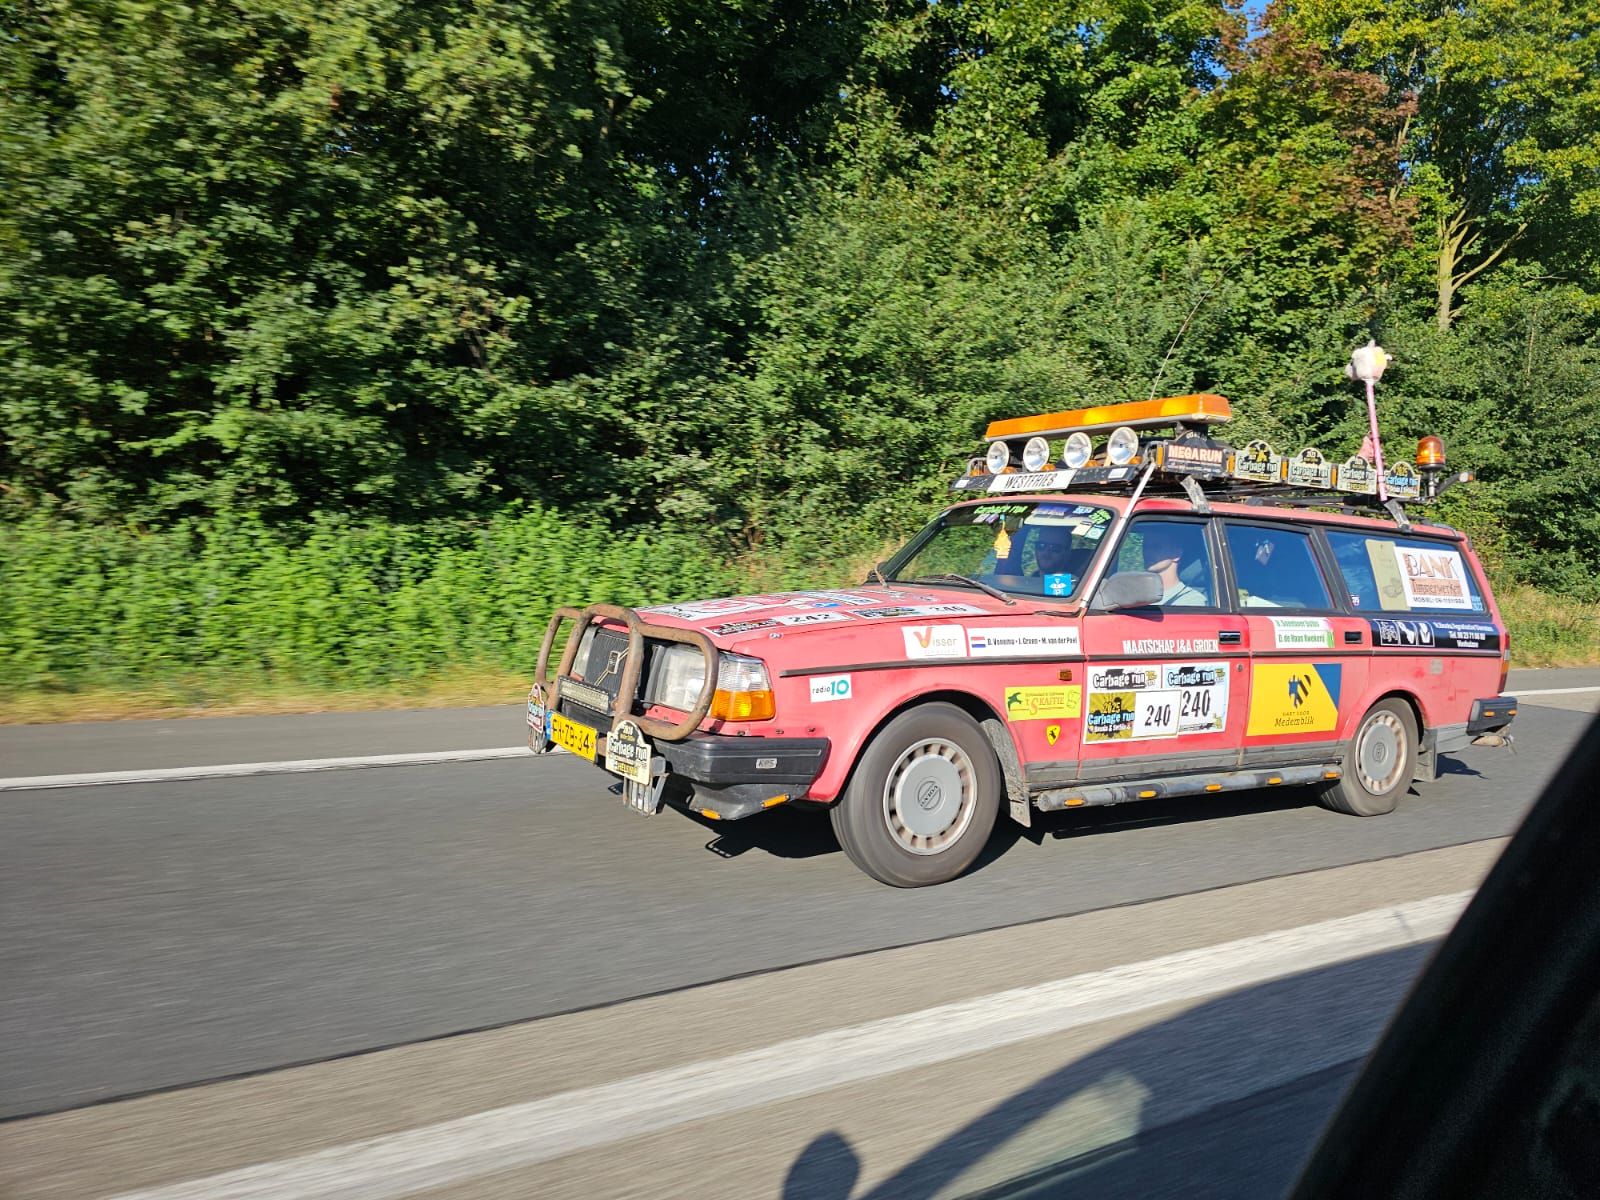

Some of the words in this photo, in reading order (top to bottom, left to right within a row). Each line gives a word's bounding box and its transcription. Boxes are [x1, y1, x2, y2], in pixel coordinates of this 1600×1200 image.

[1004, 473, 1057, 489] WESTFRIES
[1403, 552, 1458, 578] BANK
[913, 627, 957, 648] Visser
[1122, 640, 1175, 654] MAATSCHAP
[1192, 639, 1219, 653] GROEN
[1092, 673, 1129, 689] Carbage
[1131, 673, 1145, 686] run
[1167, 670, 1201, 687] Carbage
[1202, 671, 1215, 683] run
[1102, 701, 1122, 714] 2025
[1181, 689, 1211, 717] 240
[1087, 711, 1122, 725] Carbage
[1122, 711, 1136, 721] run
[1144, 704, 1171, 727] 240
[1274, 716, 1315, 727] Medemblik
